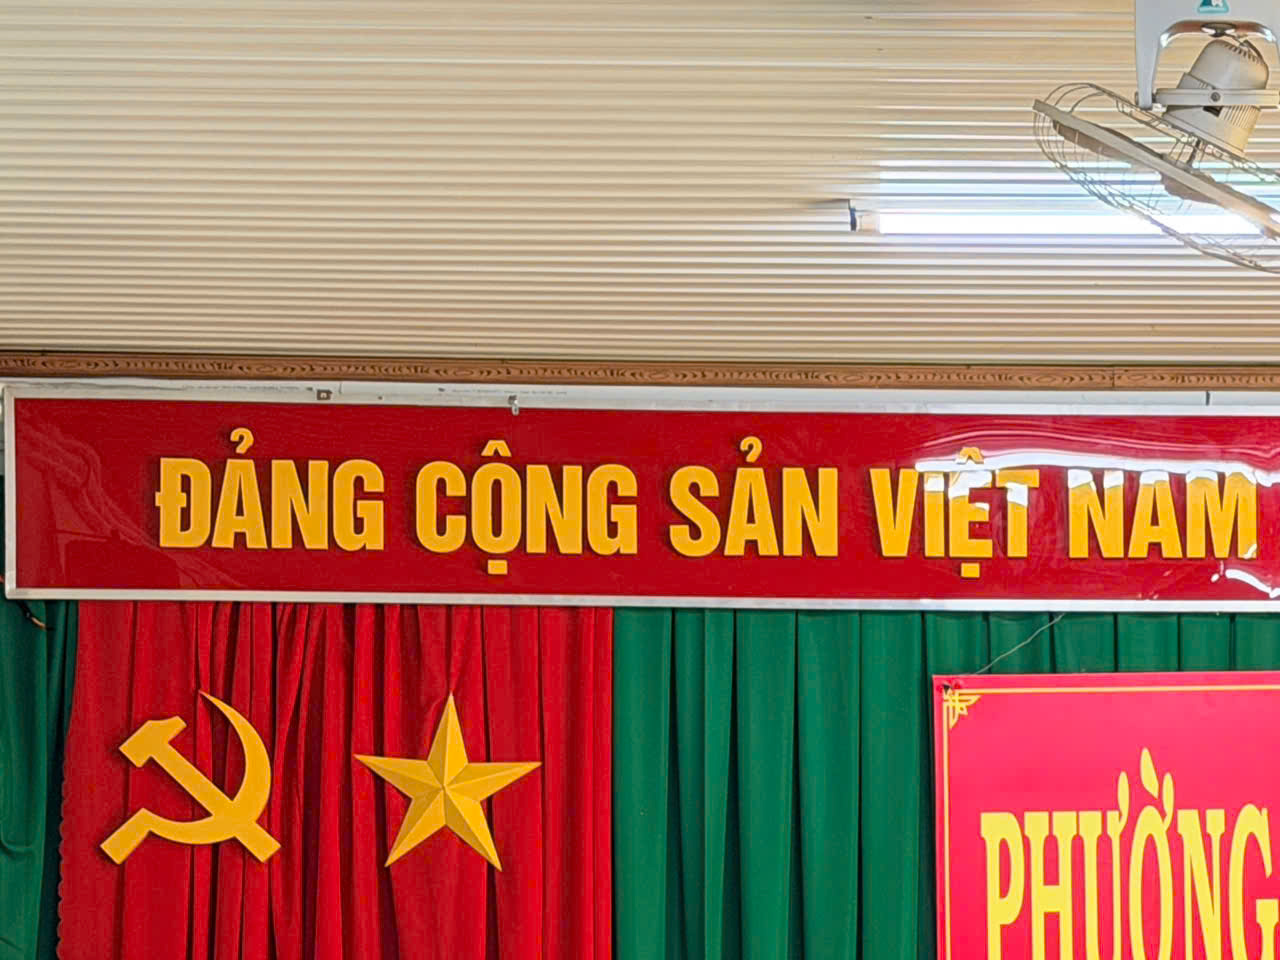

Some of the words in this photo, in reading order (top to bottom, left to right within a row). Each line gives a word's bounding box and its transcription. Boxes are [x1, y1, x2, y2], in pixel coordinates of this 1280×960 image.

[156, 428, 384, 550] ĐẢNG
[415, 440, 638, 575] CỘNG
[669, 436, 838, 557] SẢN
[869, 446, 1040, 577] VIỆT
[1067, 469, 1257, 558] NAM
